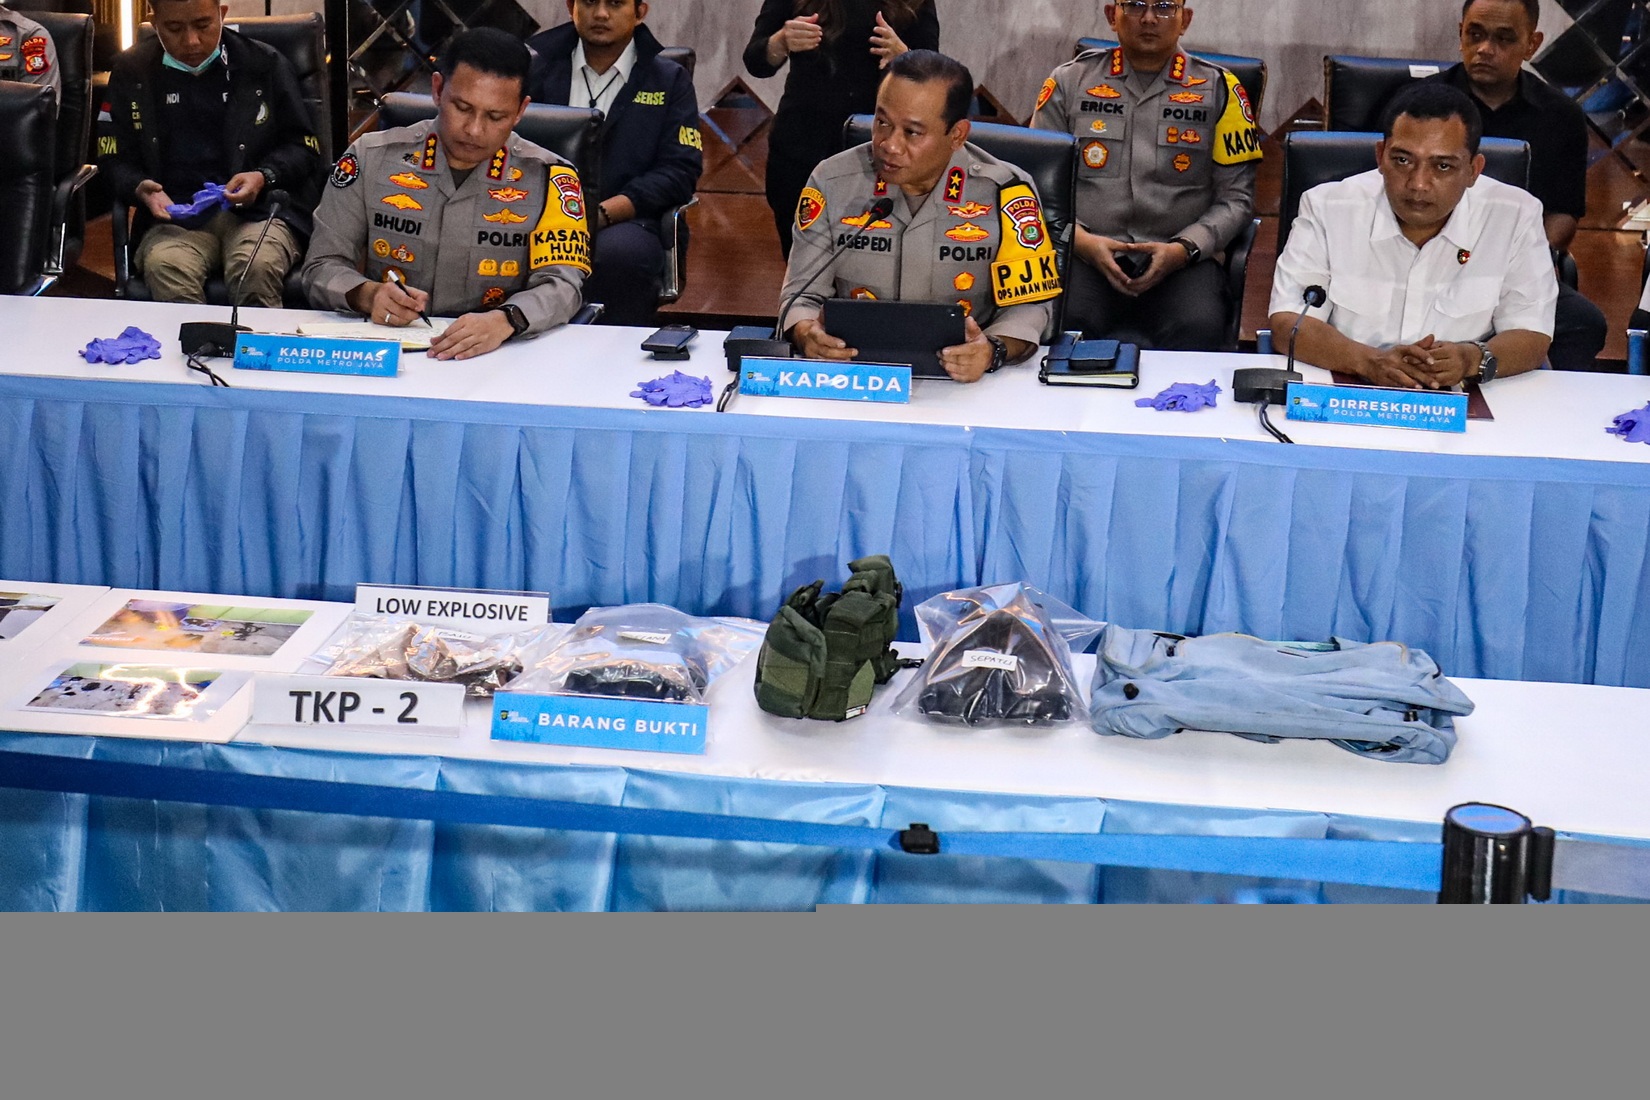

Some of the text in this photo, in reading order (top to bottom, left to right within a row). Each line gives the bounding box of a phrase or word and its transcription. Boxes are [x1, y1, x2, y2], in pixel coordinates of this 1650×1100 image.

[1080, 100, 1125, 115] ERICK
[1163, 107, 1207, 122] POLRI
[557, 177, 579, 188] POLDA
[1008, 200, 1036, 214] POLDA
[373, 212, 422, 236] BHUDI
[477, 230, 529, 247] POLRI
[533, 256, 549, 265] OPS
[551, 254, 575, 262] AMAN
[939, 245, 992, 262] POLRI
[997, 288, 1013, 300] OPS
[1014, 282, 1041, 297] AMAN
[277, 357, 312, 365] POLDA
[317, 359, 353, 367] METRO
[280, 347, 384, 361] KABID HUMAS
[779, 371, 902, 392] KAPOLDA
[1329, 398, 1457, 417] DIRRESKRIMUM
[1333, 409, 1451, 424] POLDA METRO JAYA
[376, 597, 529, 621] LOW EXPLOSIVE
[288, 690, 361, 723] TKP
[396, 691, 419, 723] 2
[538, 713, 626, 731] BARANG
[635, 720, 697, 737] BUKTI
